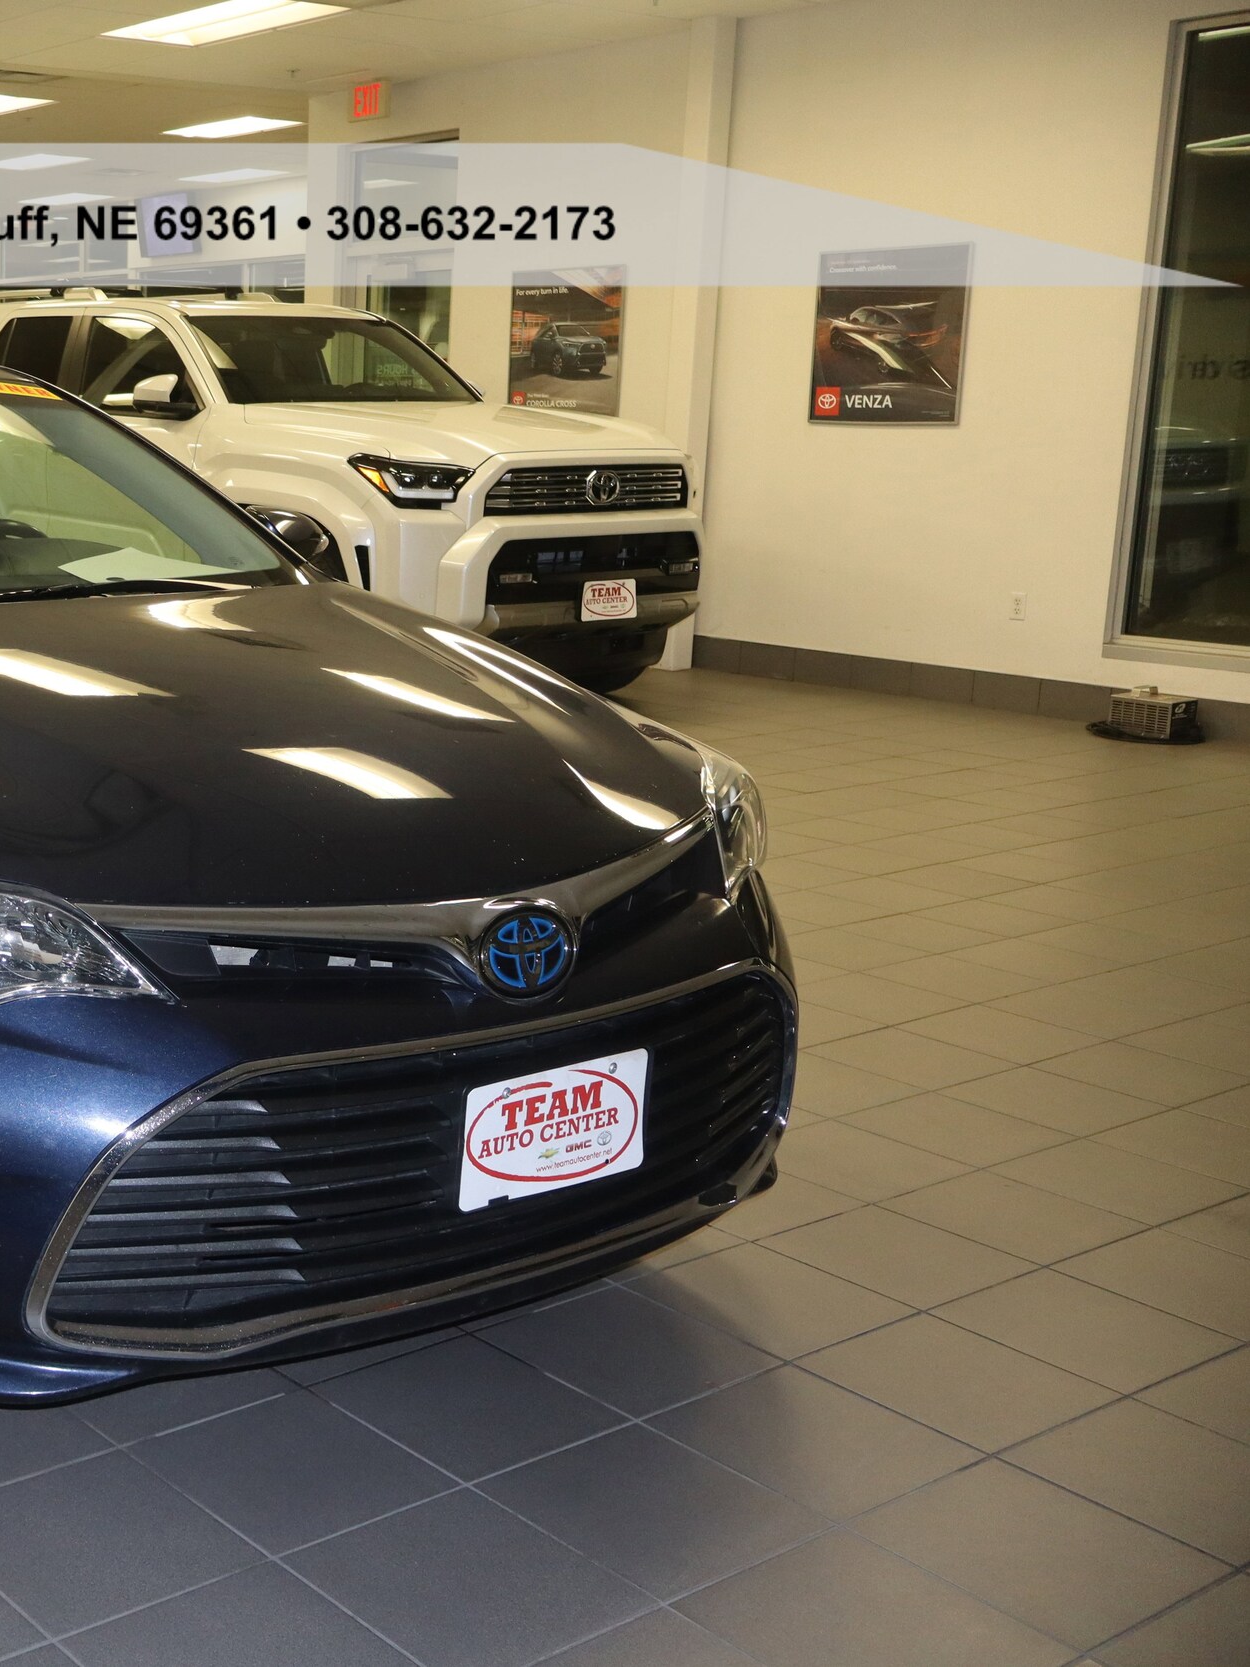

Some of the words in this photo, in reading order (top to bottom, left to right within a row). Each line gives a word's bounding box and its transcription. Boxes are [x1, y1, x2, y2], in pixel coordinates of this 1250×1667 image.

[354, 82, 381, 118] EXIT
[516, 288, 526, 296] For
[526, 288, 540, 296] every
[553, 286, 558, 294] in
[526, 400, 555, 408] COROLLA
[555, 400, 577, 408] CROSS
[845, 394, 893, 409] VENZA
[591, 587, 621, 598] TEAM
[602, 596, 628, 604] CENTER
[501, 1080, 604, 1132] TEAM
[477, 1129, 535, 1160] AUTO
[539, 1107, 620, 1143] CENTER
[565, 1139, 593, 1154] GMC
[535, 1147, 614, 1173] www.teamautocenter.net
